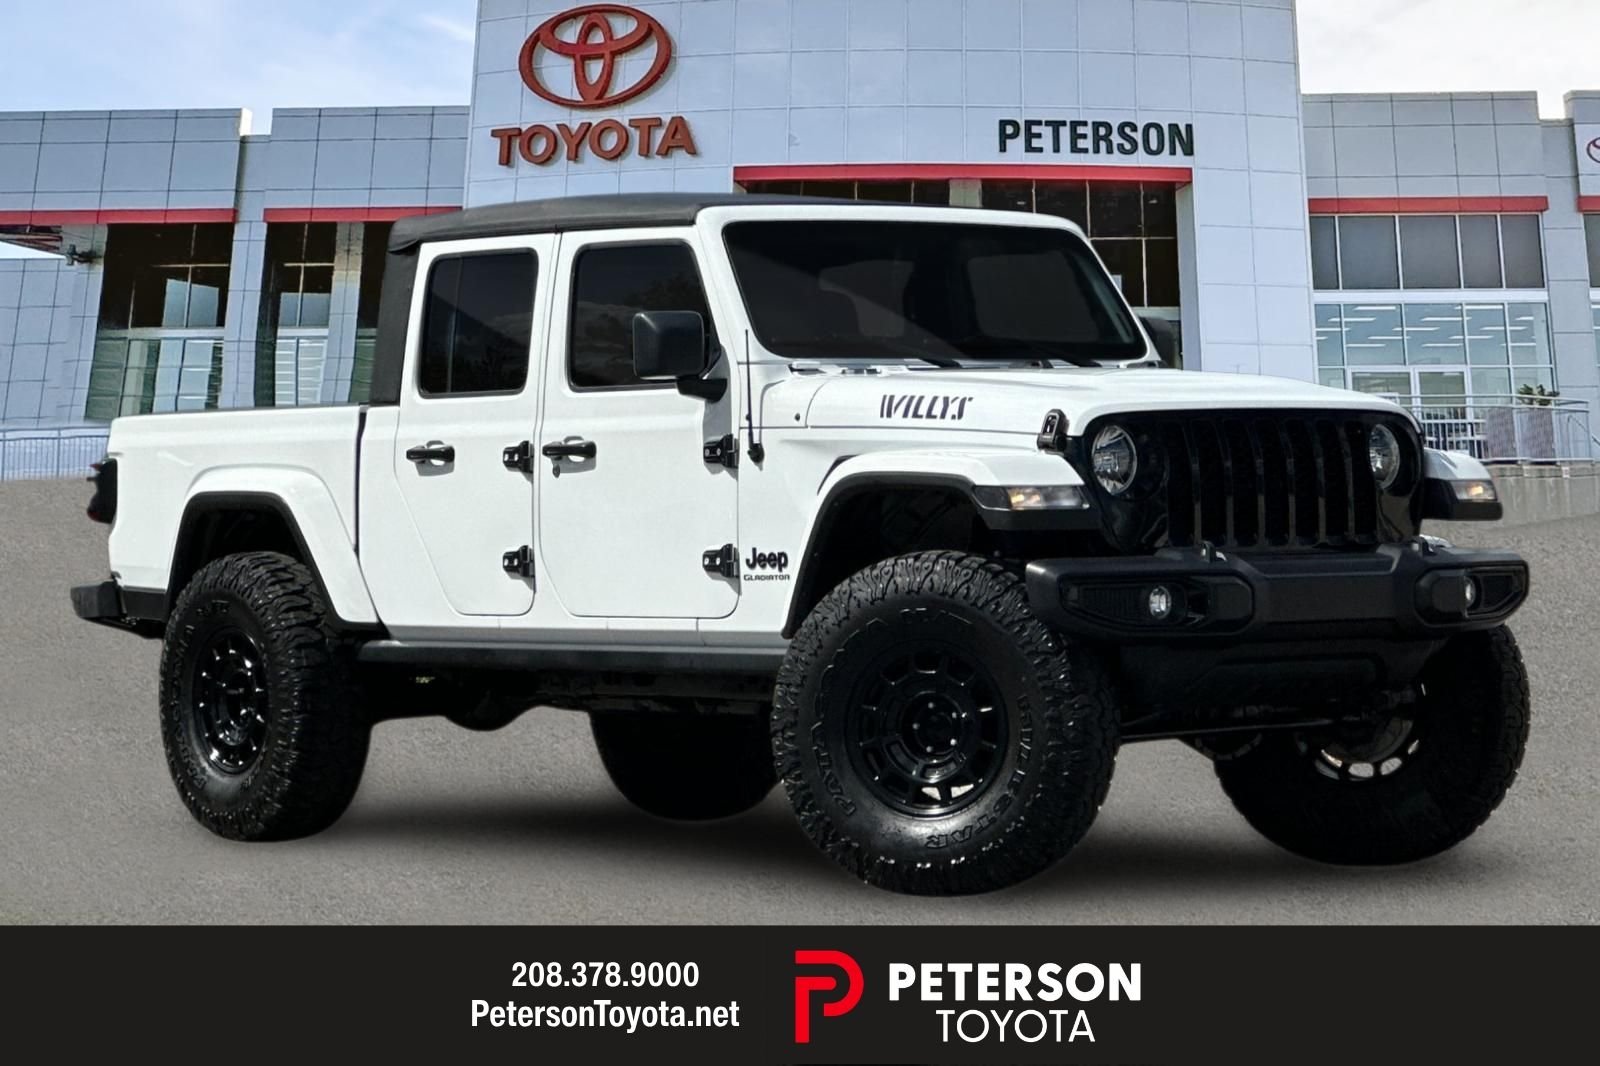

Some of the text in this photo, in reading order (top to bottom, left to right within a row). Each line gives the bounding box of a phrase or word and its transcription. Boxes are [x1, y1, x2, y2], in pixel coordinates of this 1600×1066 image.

[491, 115, 699, 168] TOYOTA
[998, 119, 1194, 156] PETERSON
[880, 394, 974, 420] WILLYS
[745, 546, 789, 573] Jeep
[743, 574, 790, 582] GLADIATOR
